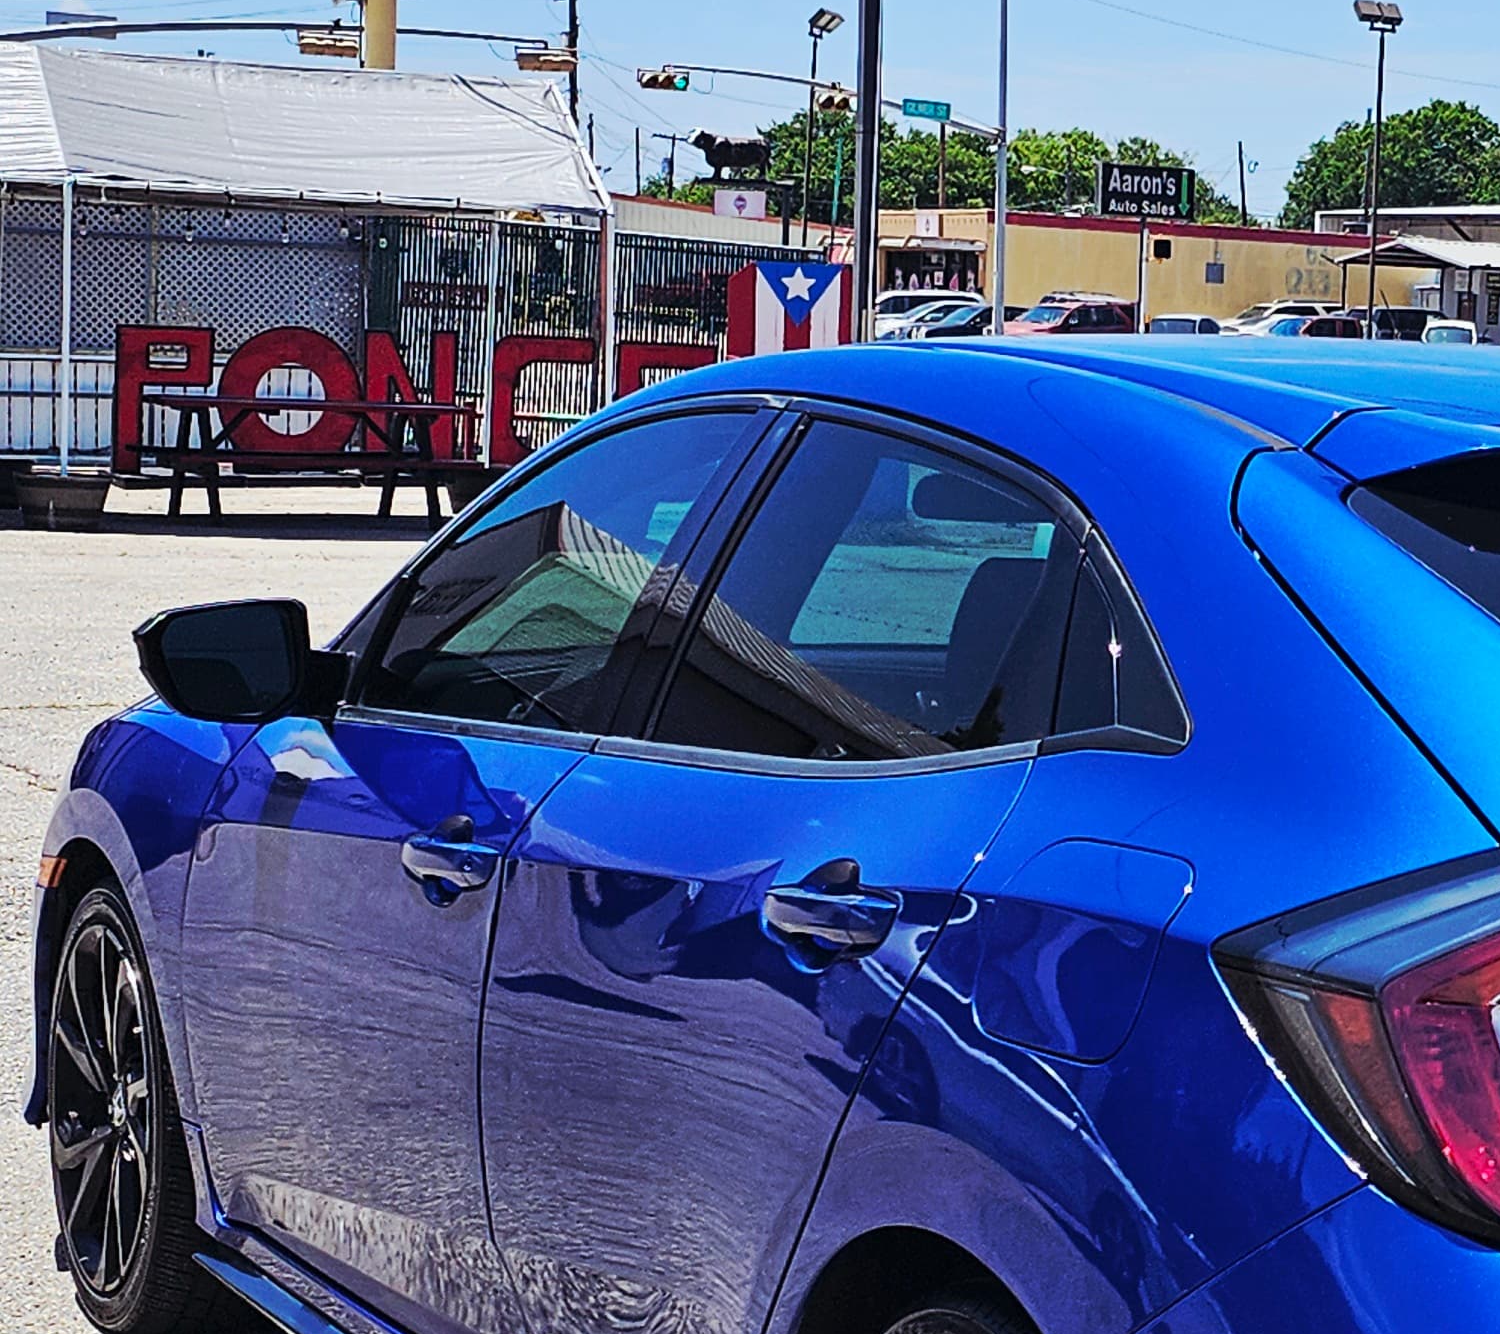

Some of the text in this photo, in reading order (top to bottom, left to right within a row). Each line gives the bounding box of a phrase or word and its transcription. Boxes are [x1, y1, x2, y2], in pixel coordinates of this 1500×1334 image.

[1108, 167, 1176, 197] Aaron's
[1108, 198, 1176, 216] Auto Sales
